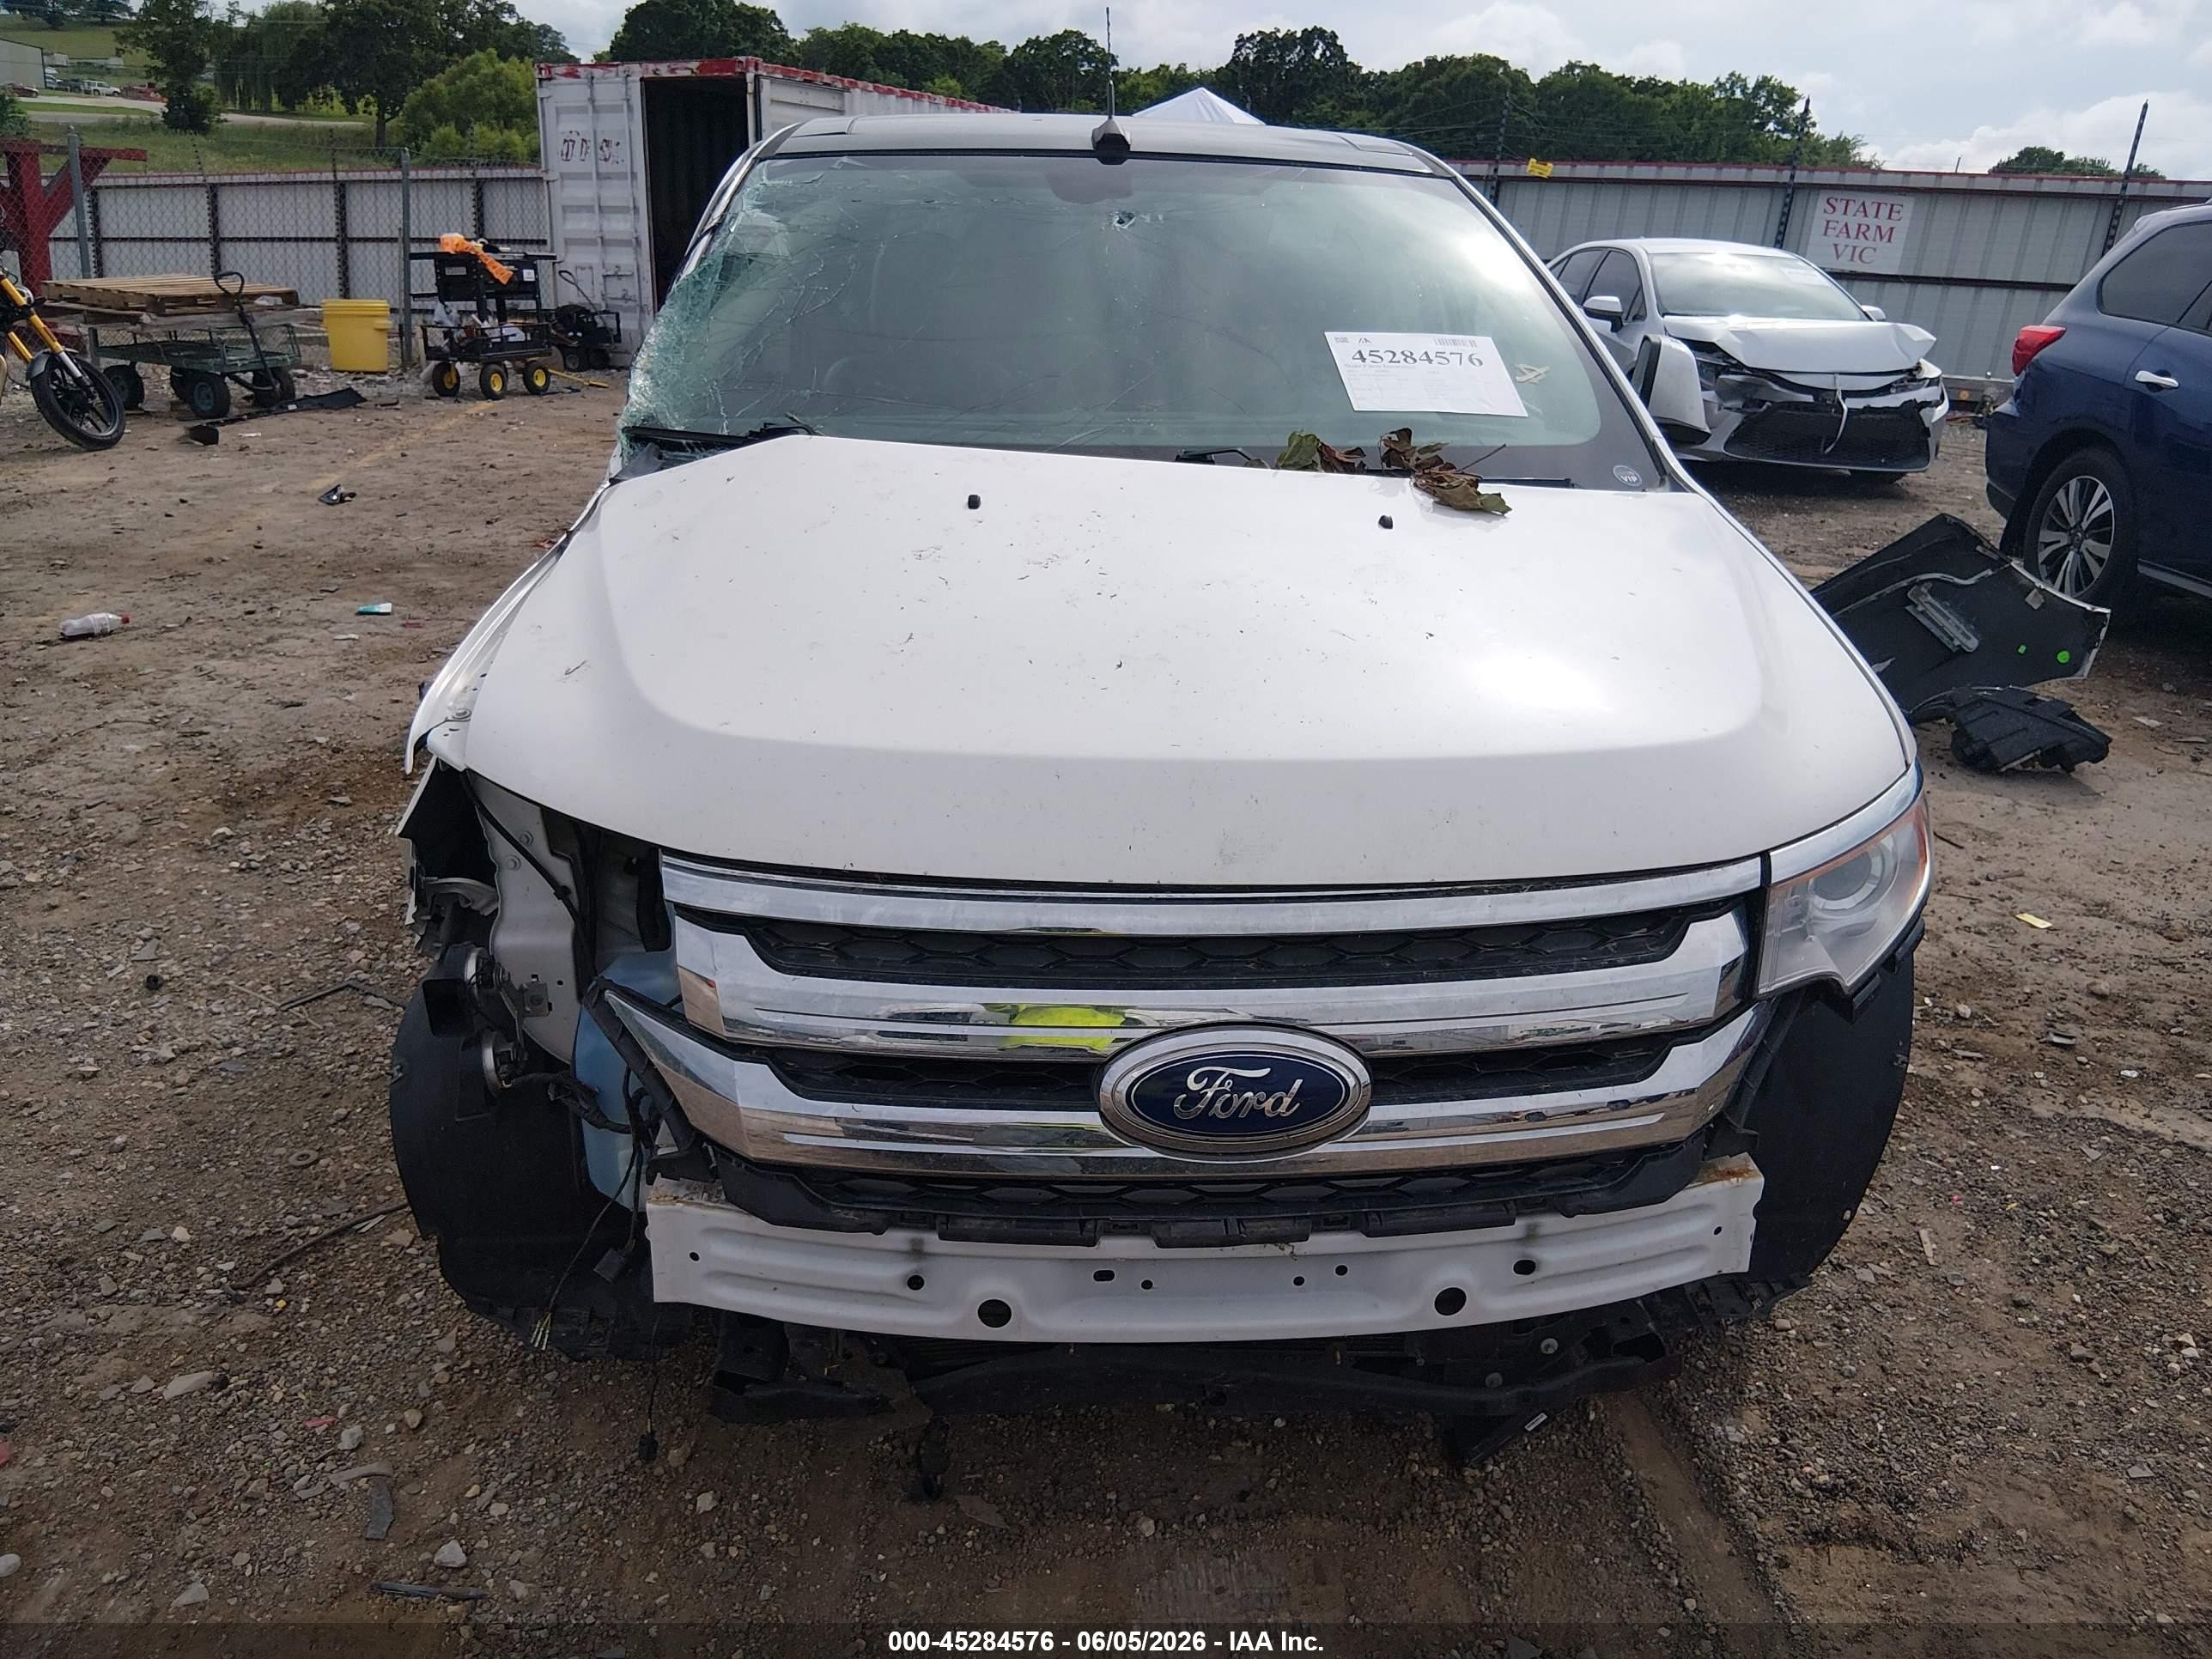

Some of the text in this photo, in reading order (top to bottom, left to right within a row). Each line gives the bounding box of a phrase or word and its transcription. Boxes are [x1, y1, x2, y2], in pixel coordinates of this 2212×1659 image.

[1823, 196, 1904, 222] STATE
[1822, 219, 1896, 245] FARM
[1832, 242, 1877, 264] VIC
[1352, 349, 1484, 367] 45284576
[1173, 1066, 1304, 1120] Ford
